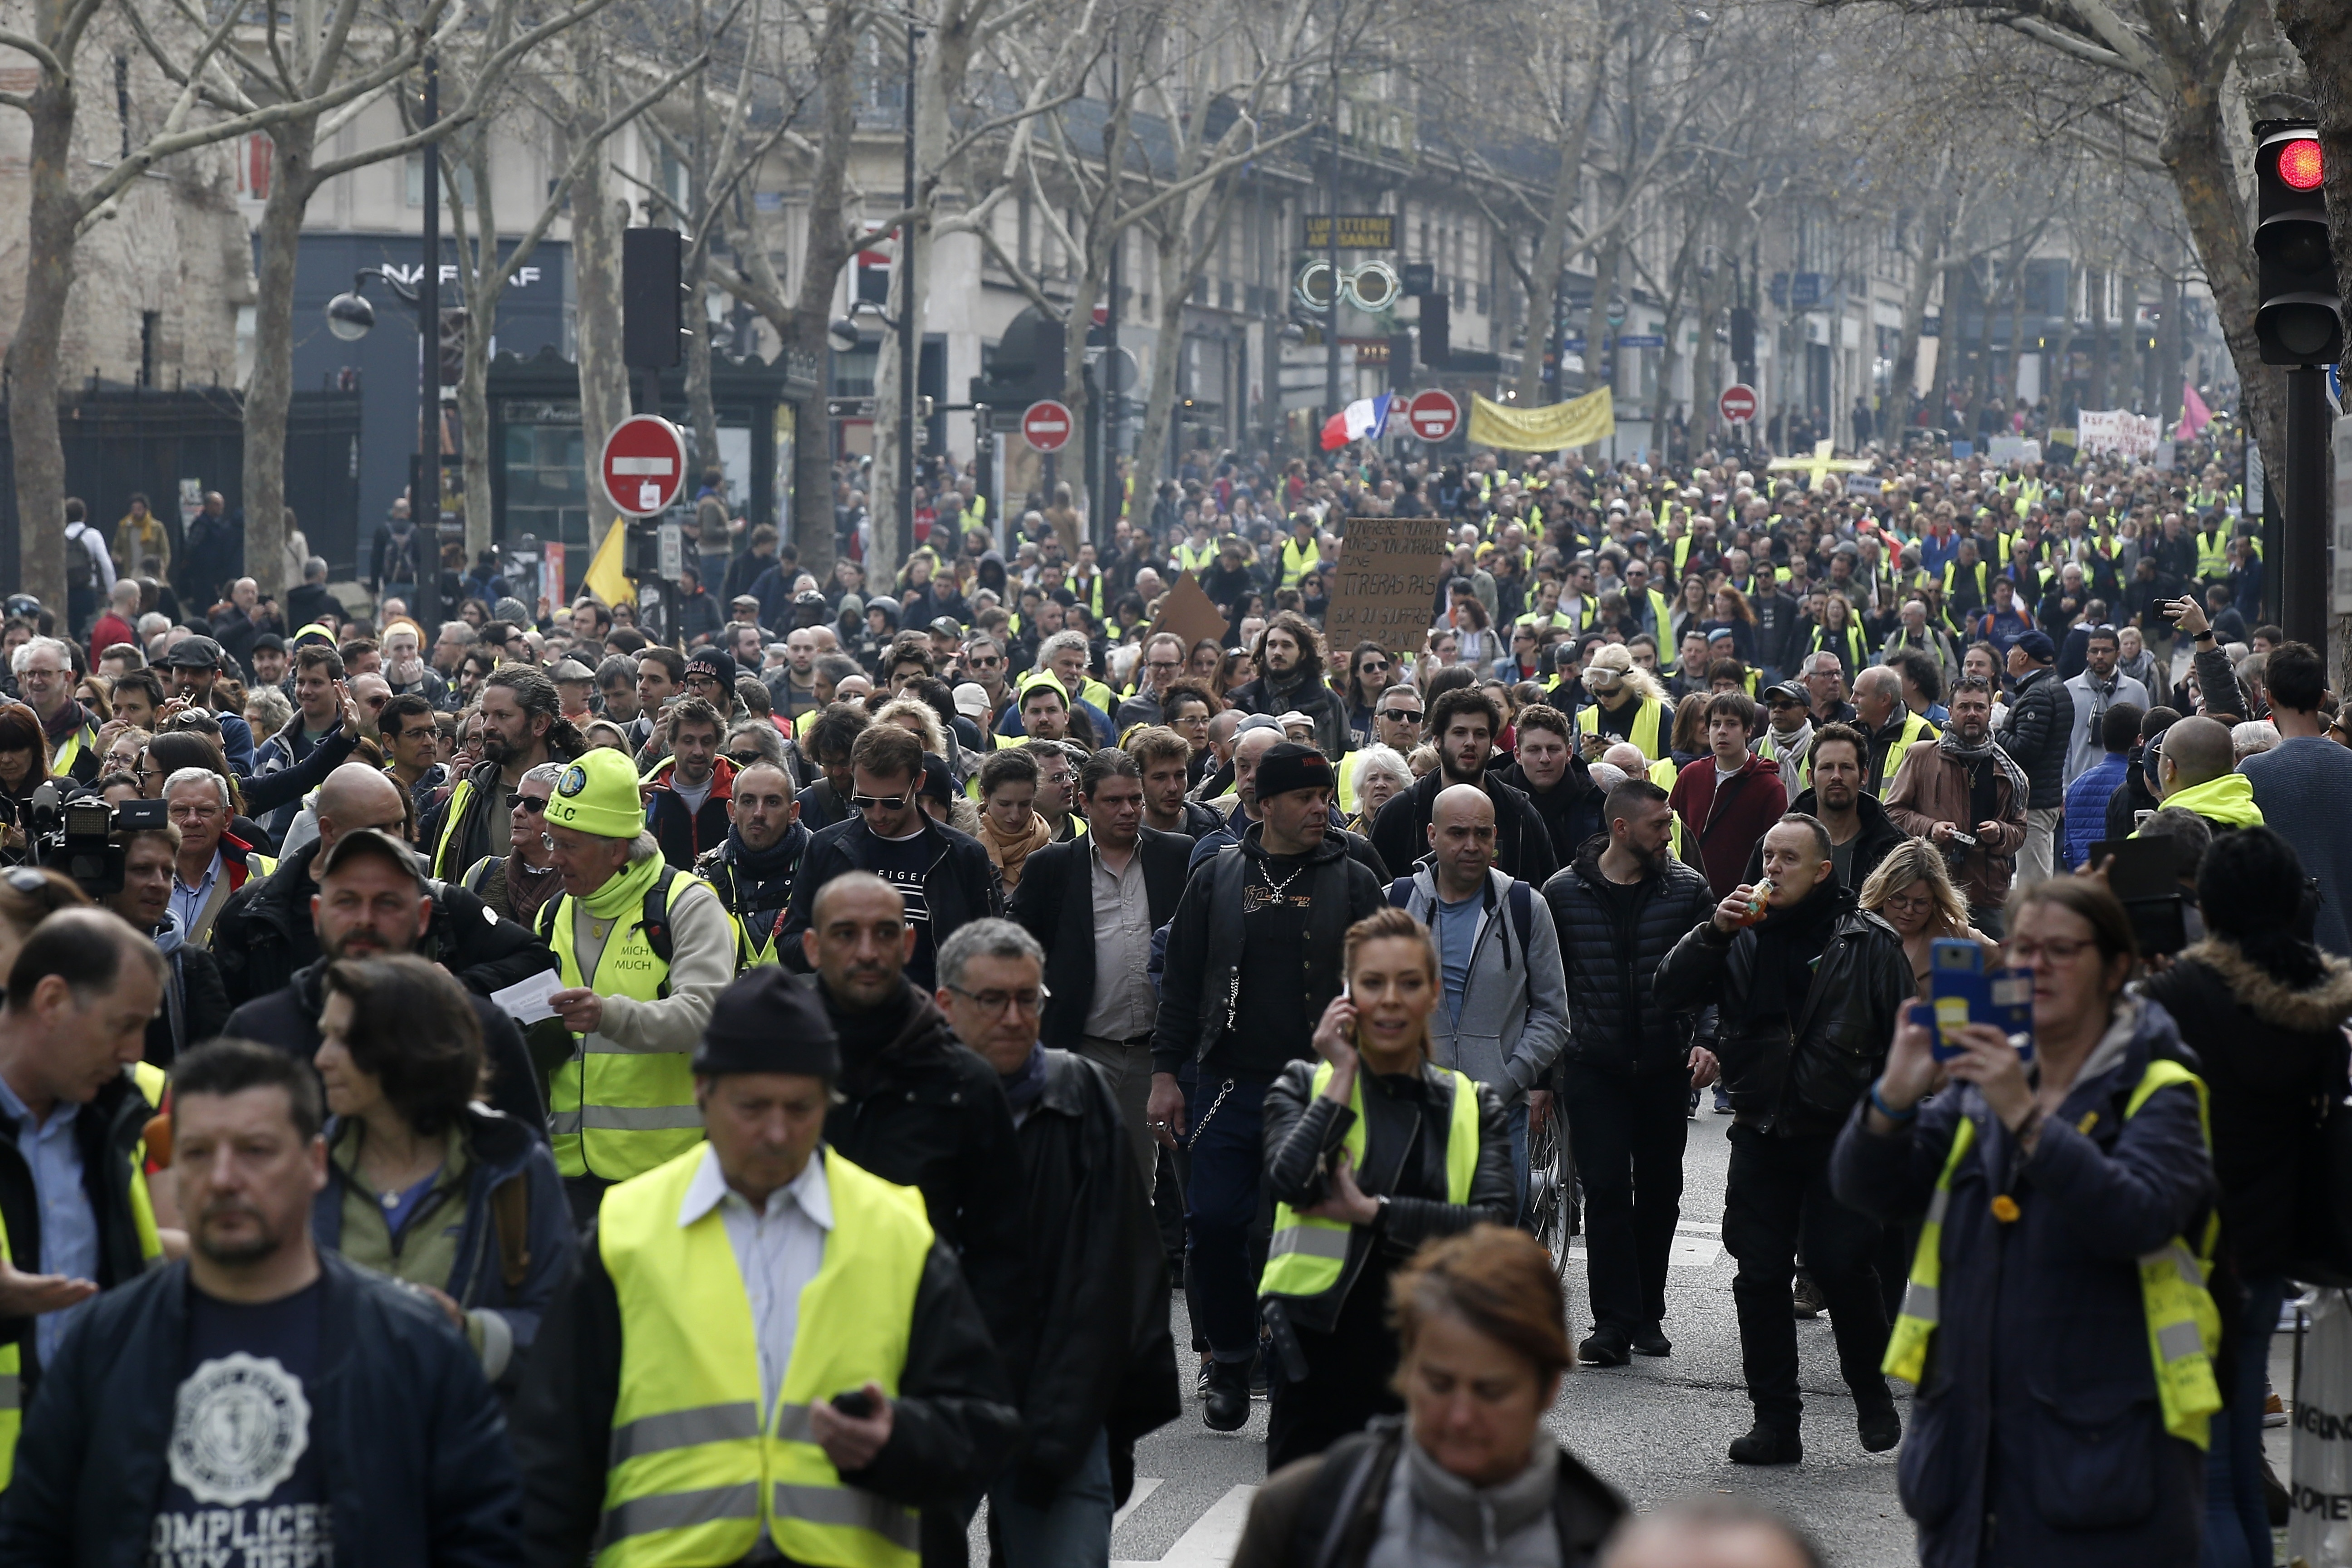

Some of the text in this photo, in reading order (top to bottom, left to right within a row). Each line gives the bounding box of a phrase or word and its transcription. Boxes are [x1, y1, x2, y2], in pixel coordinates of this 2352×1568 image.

[1343, 573, 1436, 596] TIRERAS PAS
[1334, 607, 1428, 625] SUR QUI SOUFFRE
[1334, 629, 1351, 647] ET
[1378, 629, 1419, 647] PLAINT
[620, 945, 650, 956] MICH
[614, 959, 652, 971] MUCH
